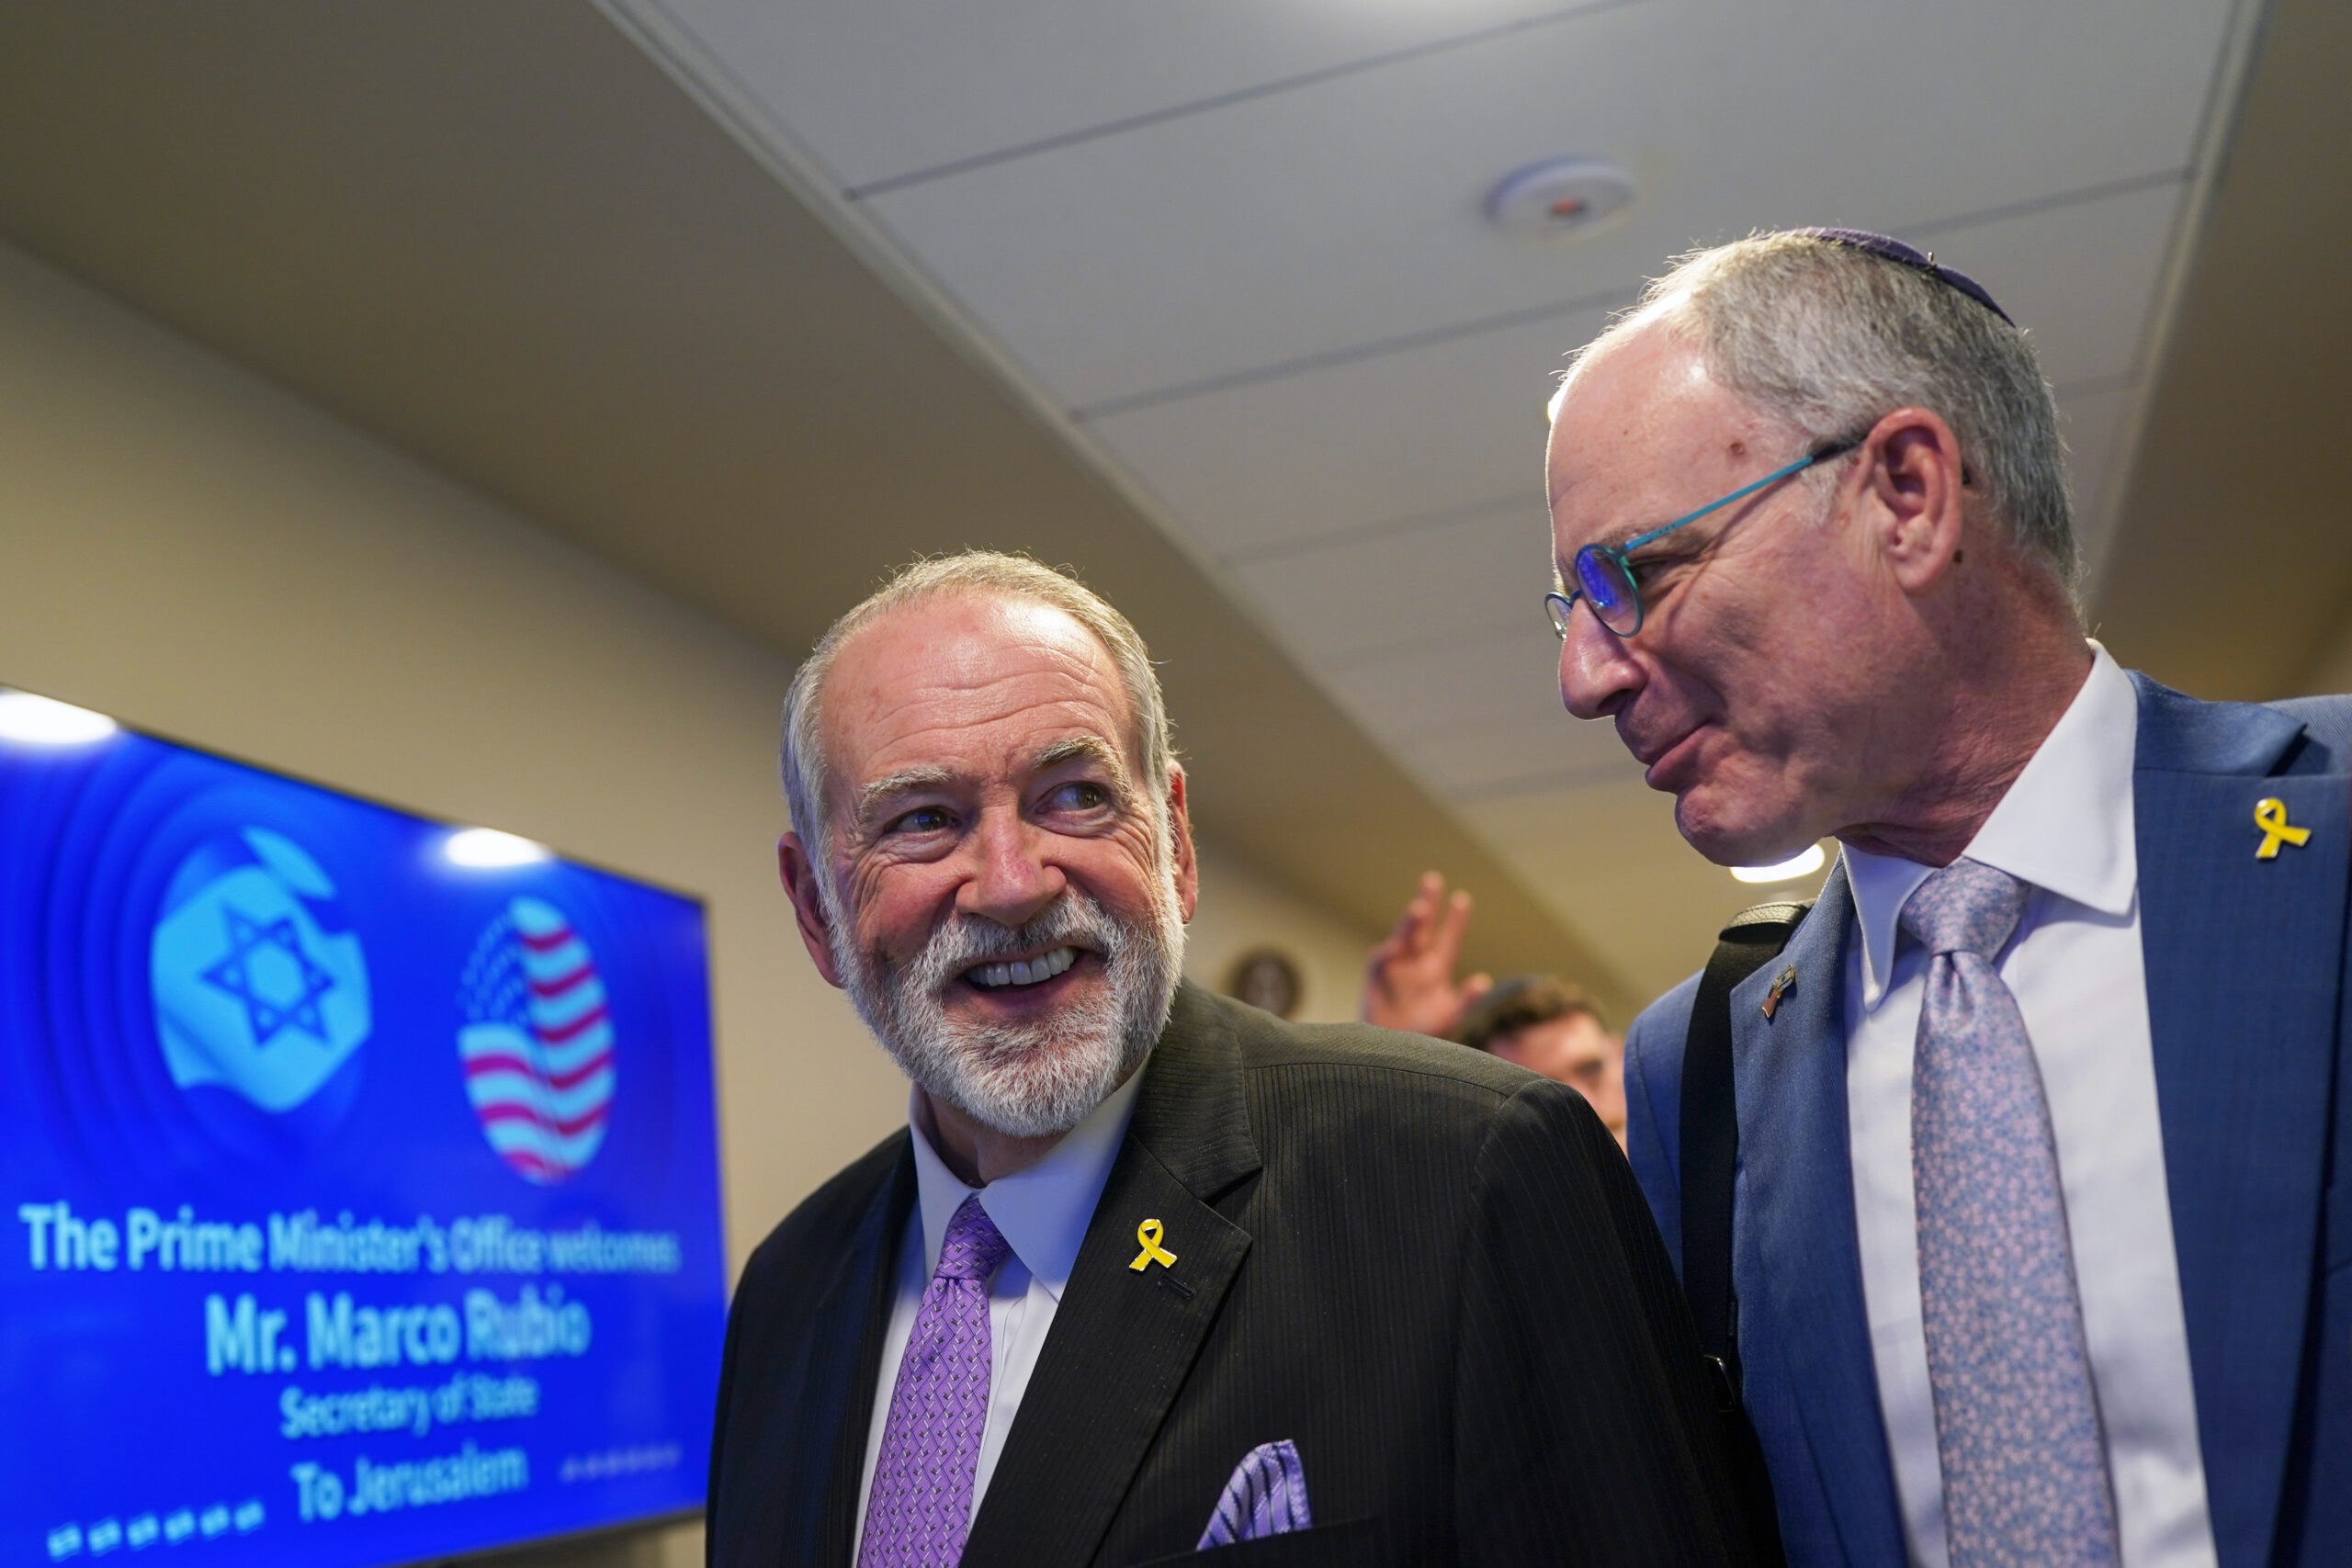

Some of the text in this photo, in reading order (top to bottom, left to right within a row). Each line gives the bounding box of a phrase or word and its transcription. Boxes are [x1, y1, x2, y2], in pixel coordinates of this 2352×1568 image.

[20, 1201, 117, 1270] The
[127, 1206, 263, 1271] Prime
[268, 1208, 447, 1273] Minister's
[450, 1213, 544, 1274] Office
[204, 1283, 591, 1375] Mr. Marco Rubio
[279, 1371, 538, 1438] Secretary of State
[288, 1439, 527, 1522] To Jerusalem
